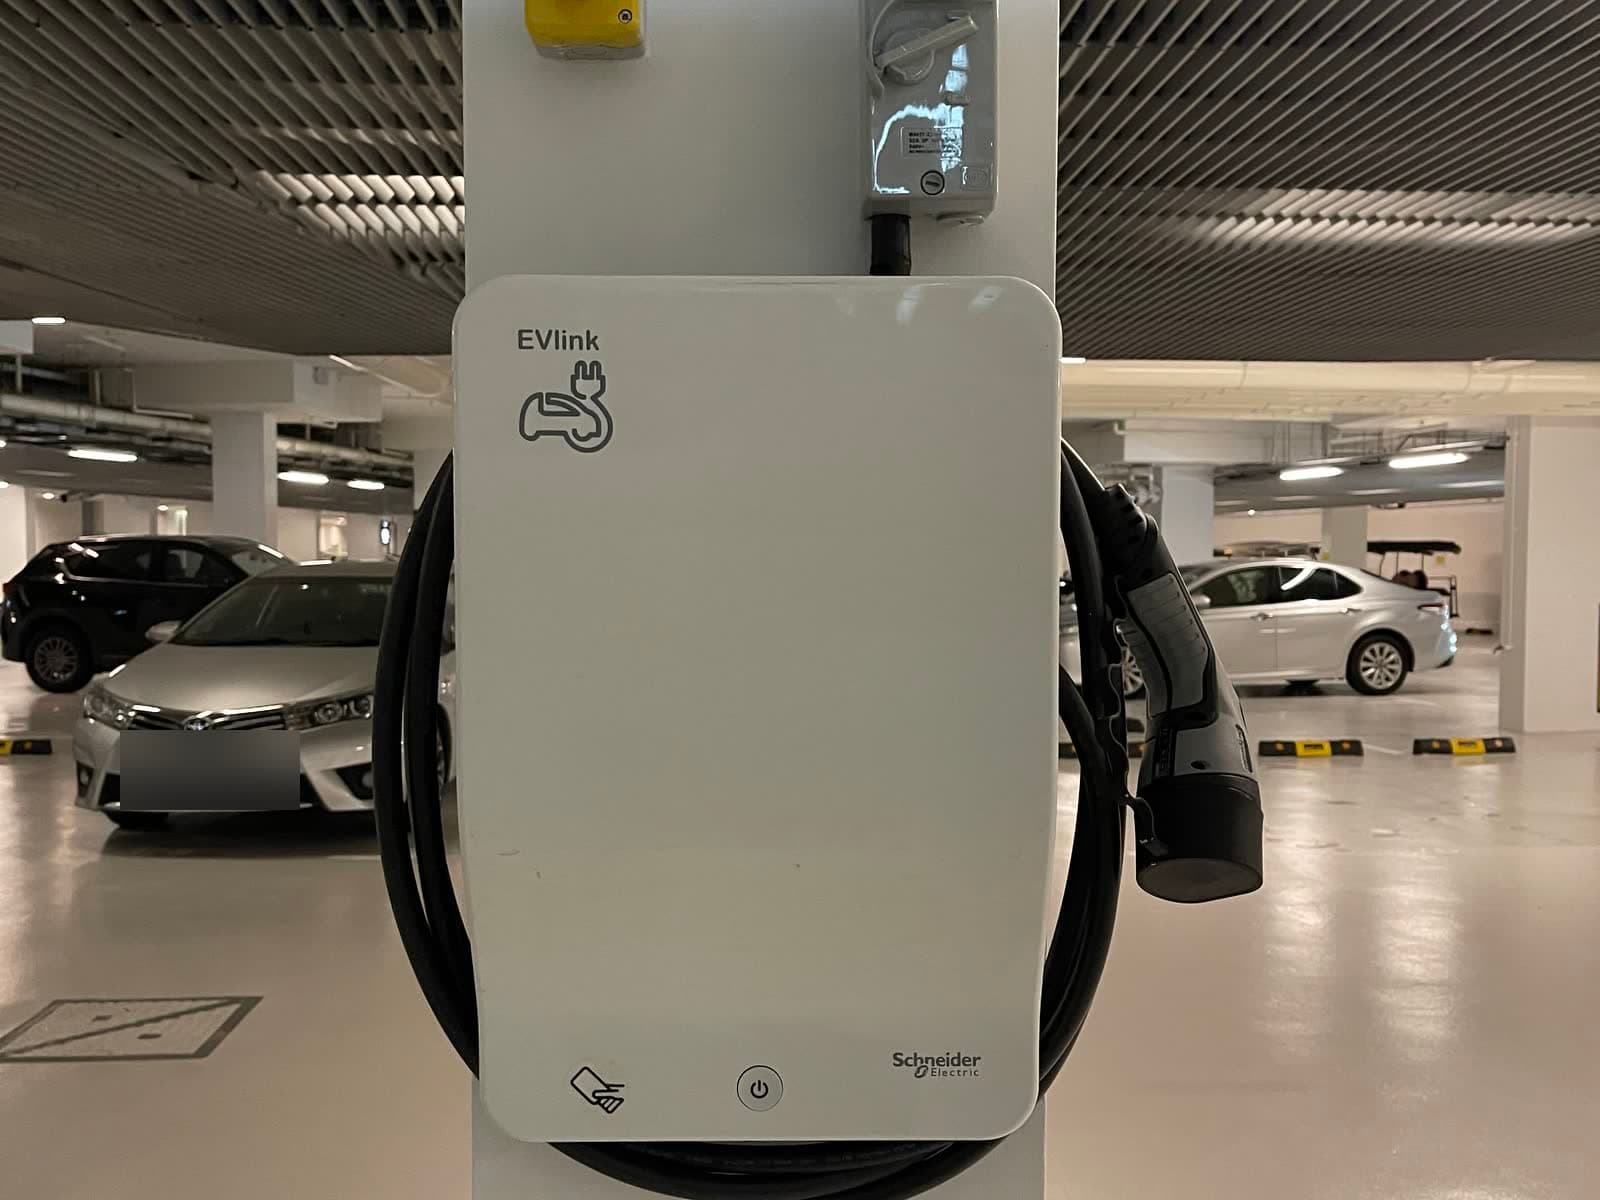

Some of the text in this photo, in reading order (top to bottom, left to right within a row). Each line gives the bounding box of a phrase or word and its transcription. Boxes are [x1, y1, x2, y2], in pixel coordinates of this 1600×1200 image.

[518, 329, 600, 350] EVlink
[892, 1052, 982, 1067] Schneider
[930, 1067, 980, 1077] Electric
